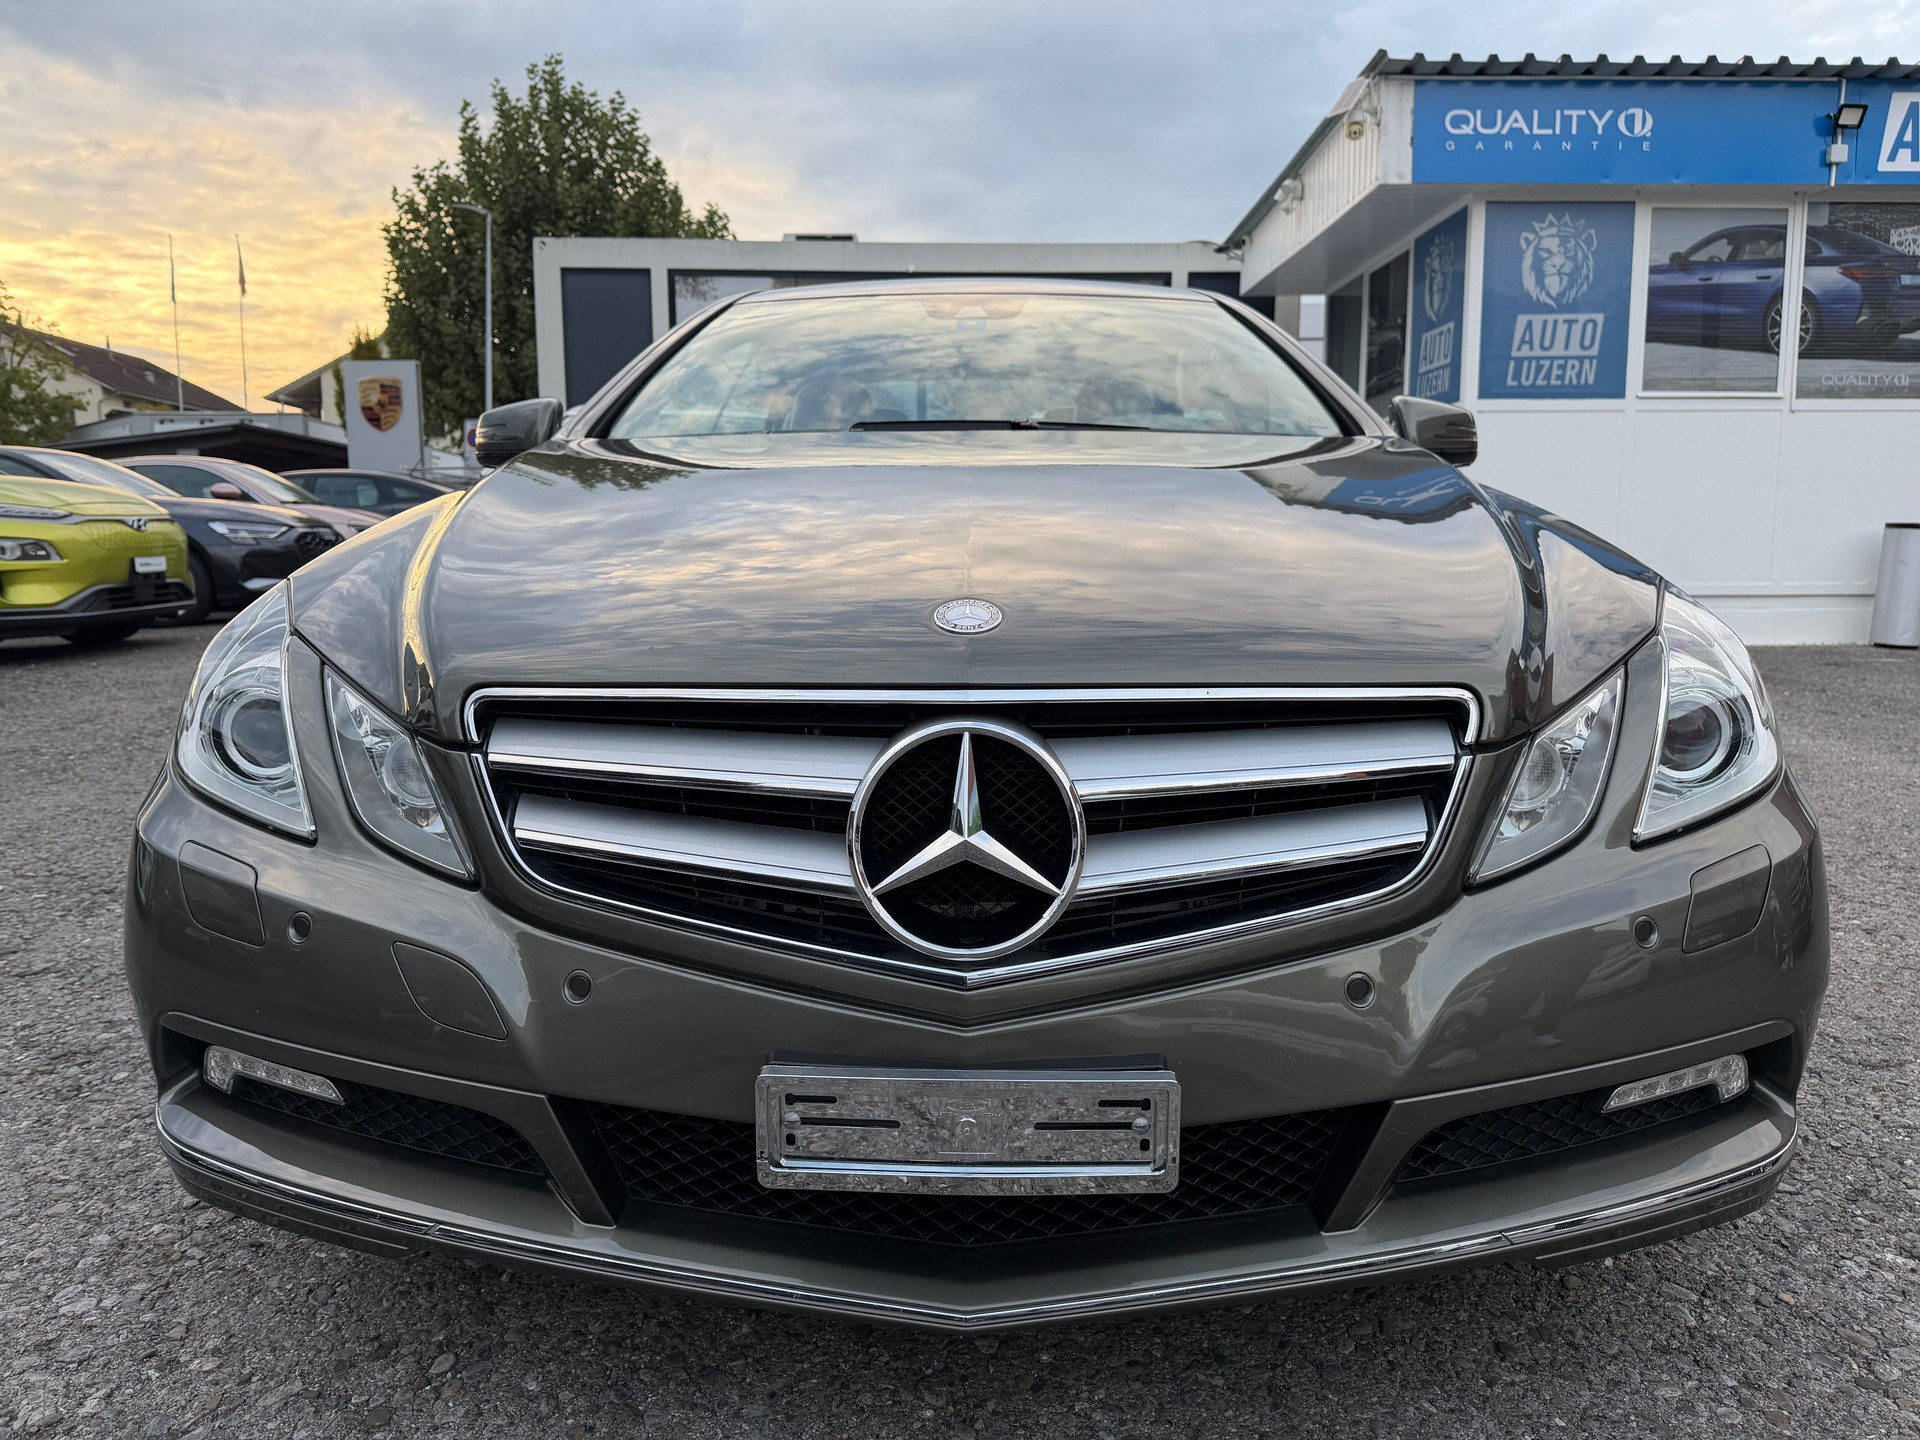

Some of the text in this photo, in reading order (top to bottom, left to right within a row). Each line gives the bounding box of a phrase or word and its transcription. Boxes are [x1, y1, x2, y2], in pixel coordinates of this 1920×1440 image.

[1444, 108, 1614, 135] QUALITY
[1445, 140, 1651, 151] GARANTIE
[1420, 327, 1452, 369] AUTO
[1516, 318, 1599, 352] AUTO
[1416, 365, 1452, 398] LUZERN
[1506, 358, 1598, 387] LUZERN
[1821, 374, 1892, 386] QUALITY
